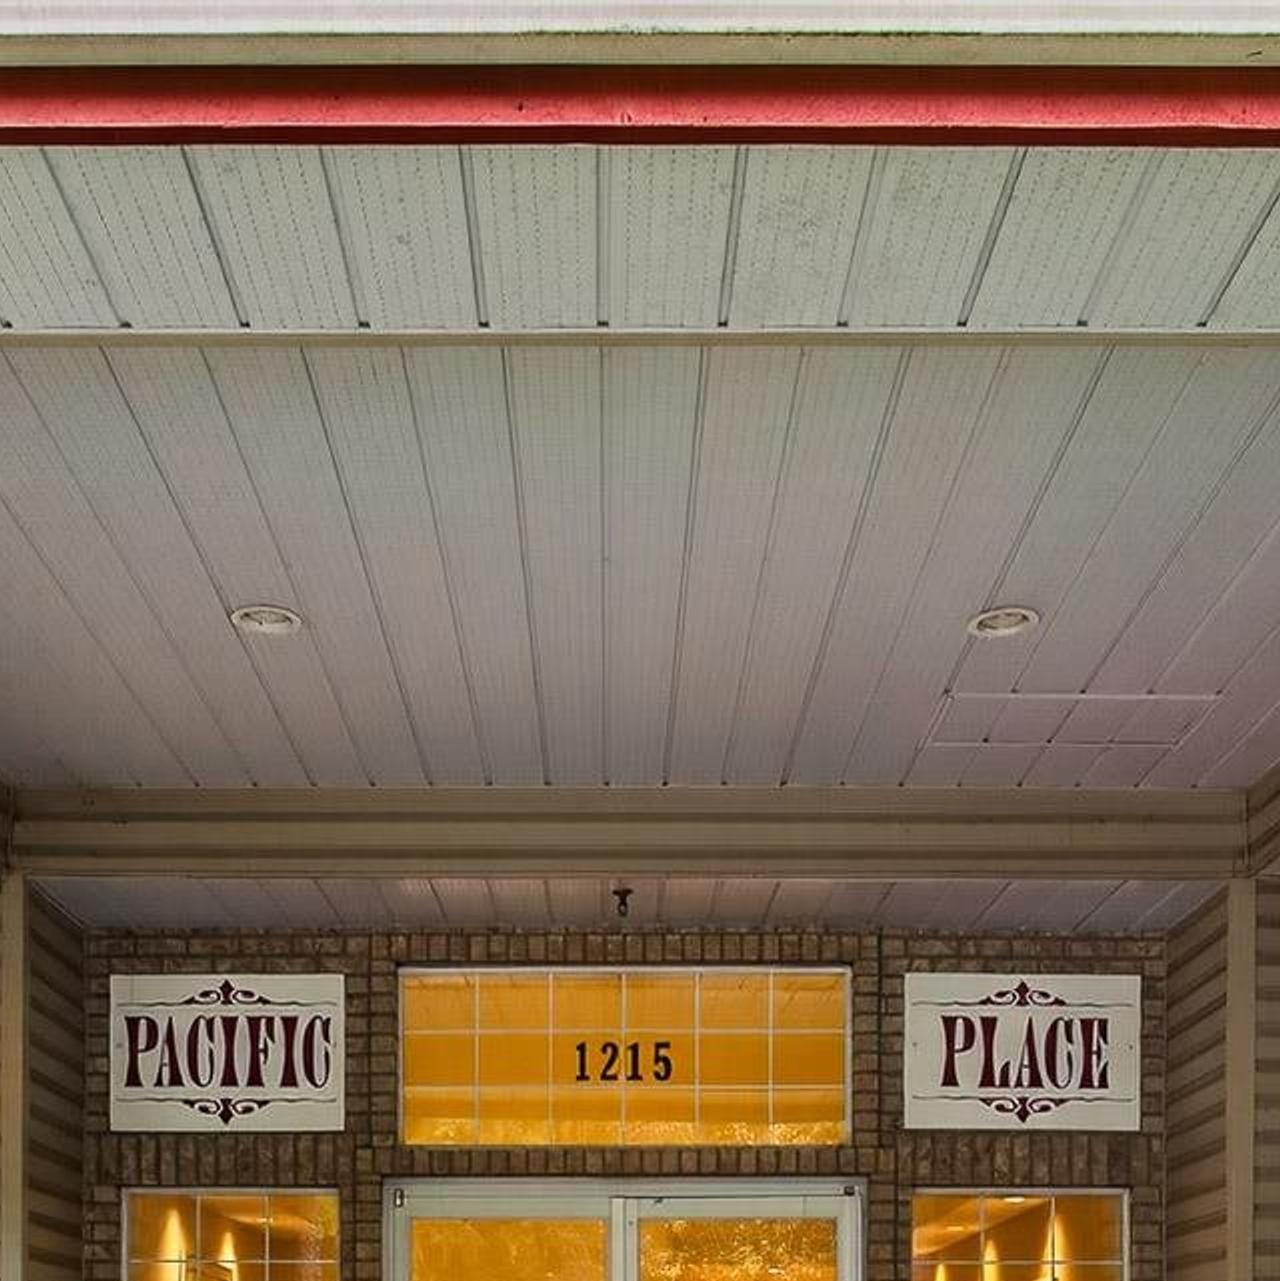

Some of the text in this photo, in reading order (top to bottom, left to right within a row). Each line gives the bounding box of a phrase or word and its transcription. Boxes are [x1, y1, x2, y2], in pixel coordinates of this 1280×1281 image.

[124, 1015, 333, 1089] PACIFIC
[575, 1041, 673, 1082] 1215
[940, 1015, 1110, 1089] PLACE
